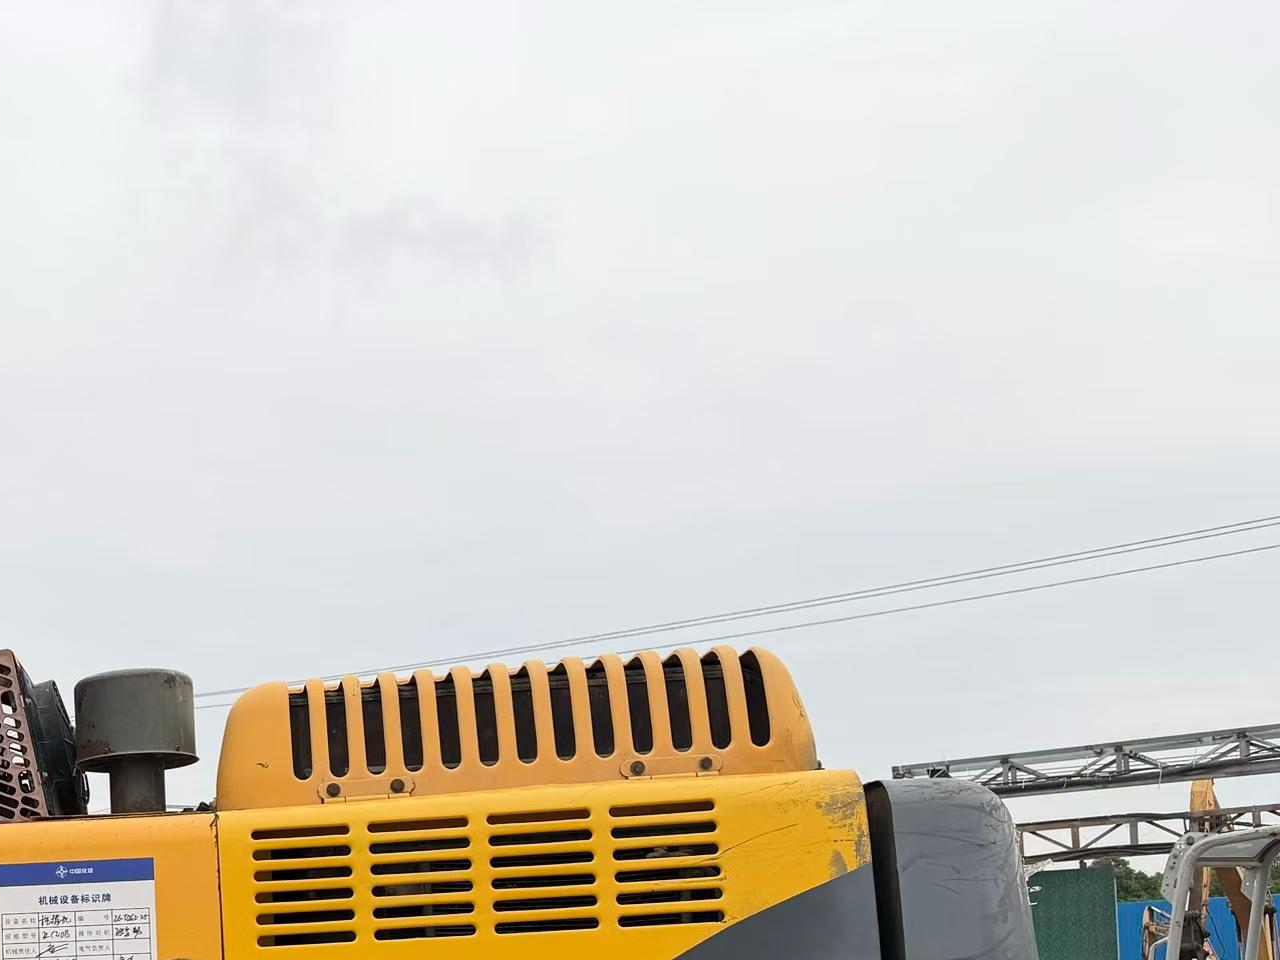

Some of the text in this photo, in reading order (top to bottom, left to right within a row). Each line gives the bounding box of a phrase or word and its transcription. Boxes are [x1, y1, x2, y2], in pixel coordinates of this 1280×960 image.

[38, 893, 112, 906] 机械设备标识牌
